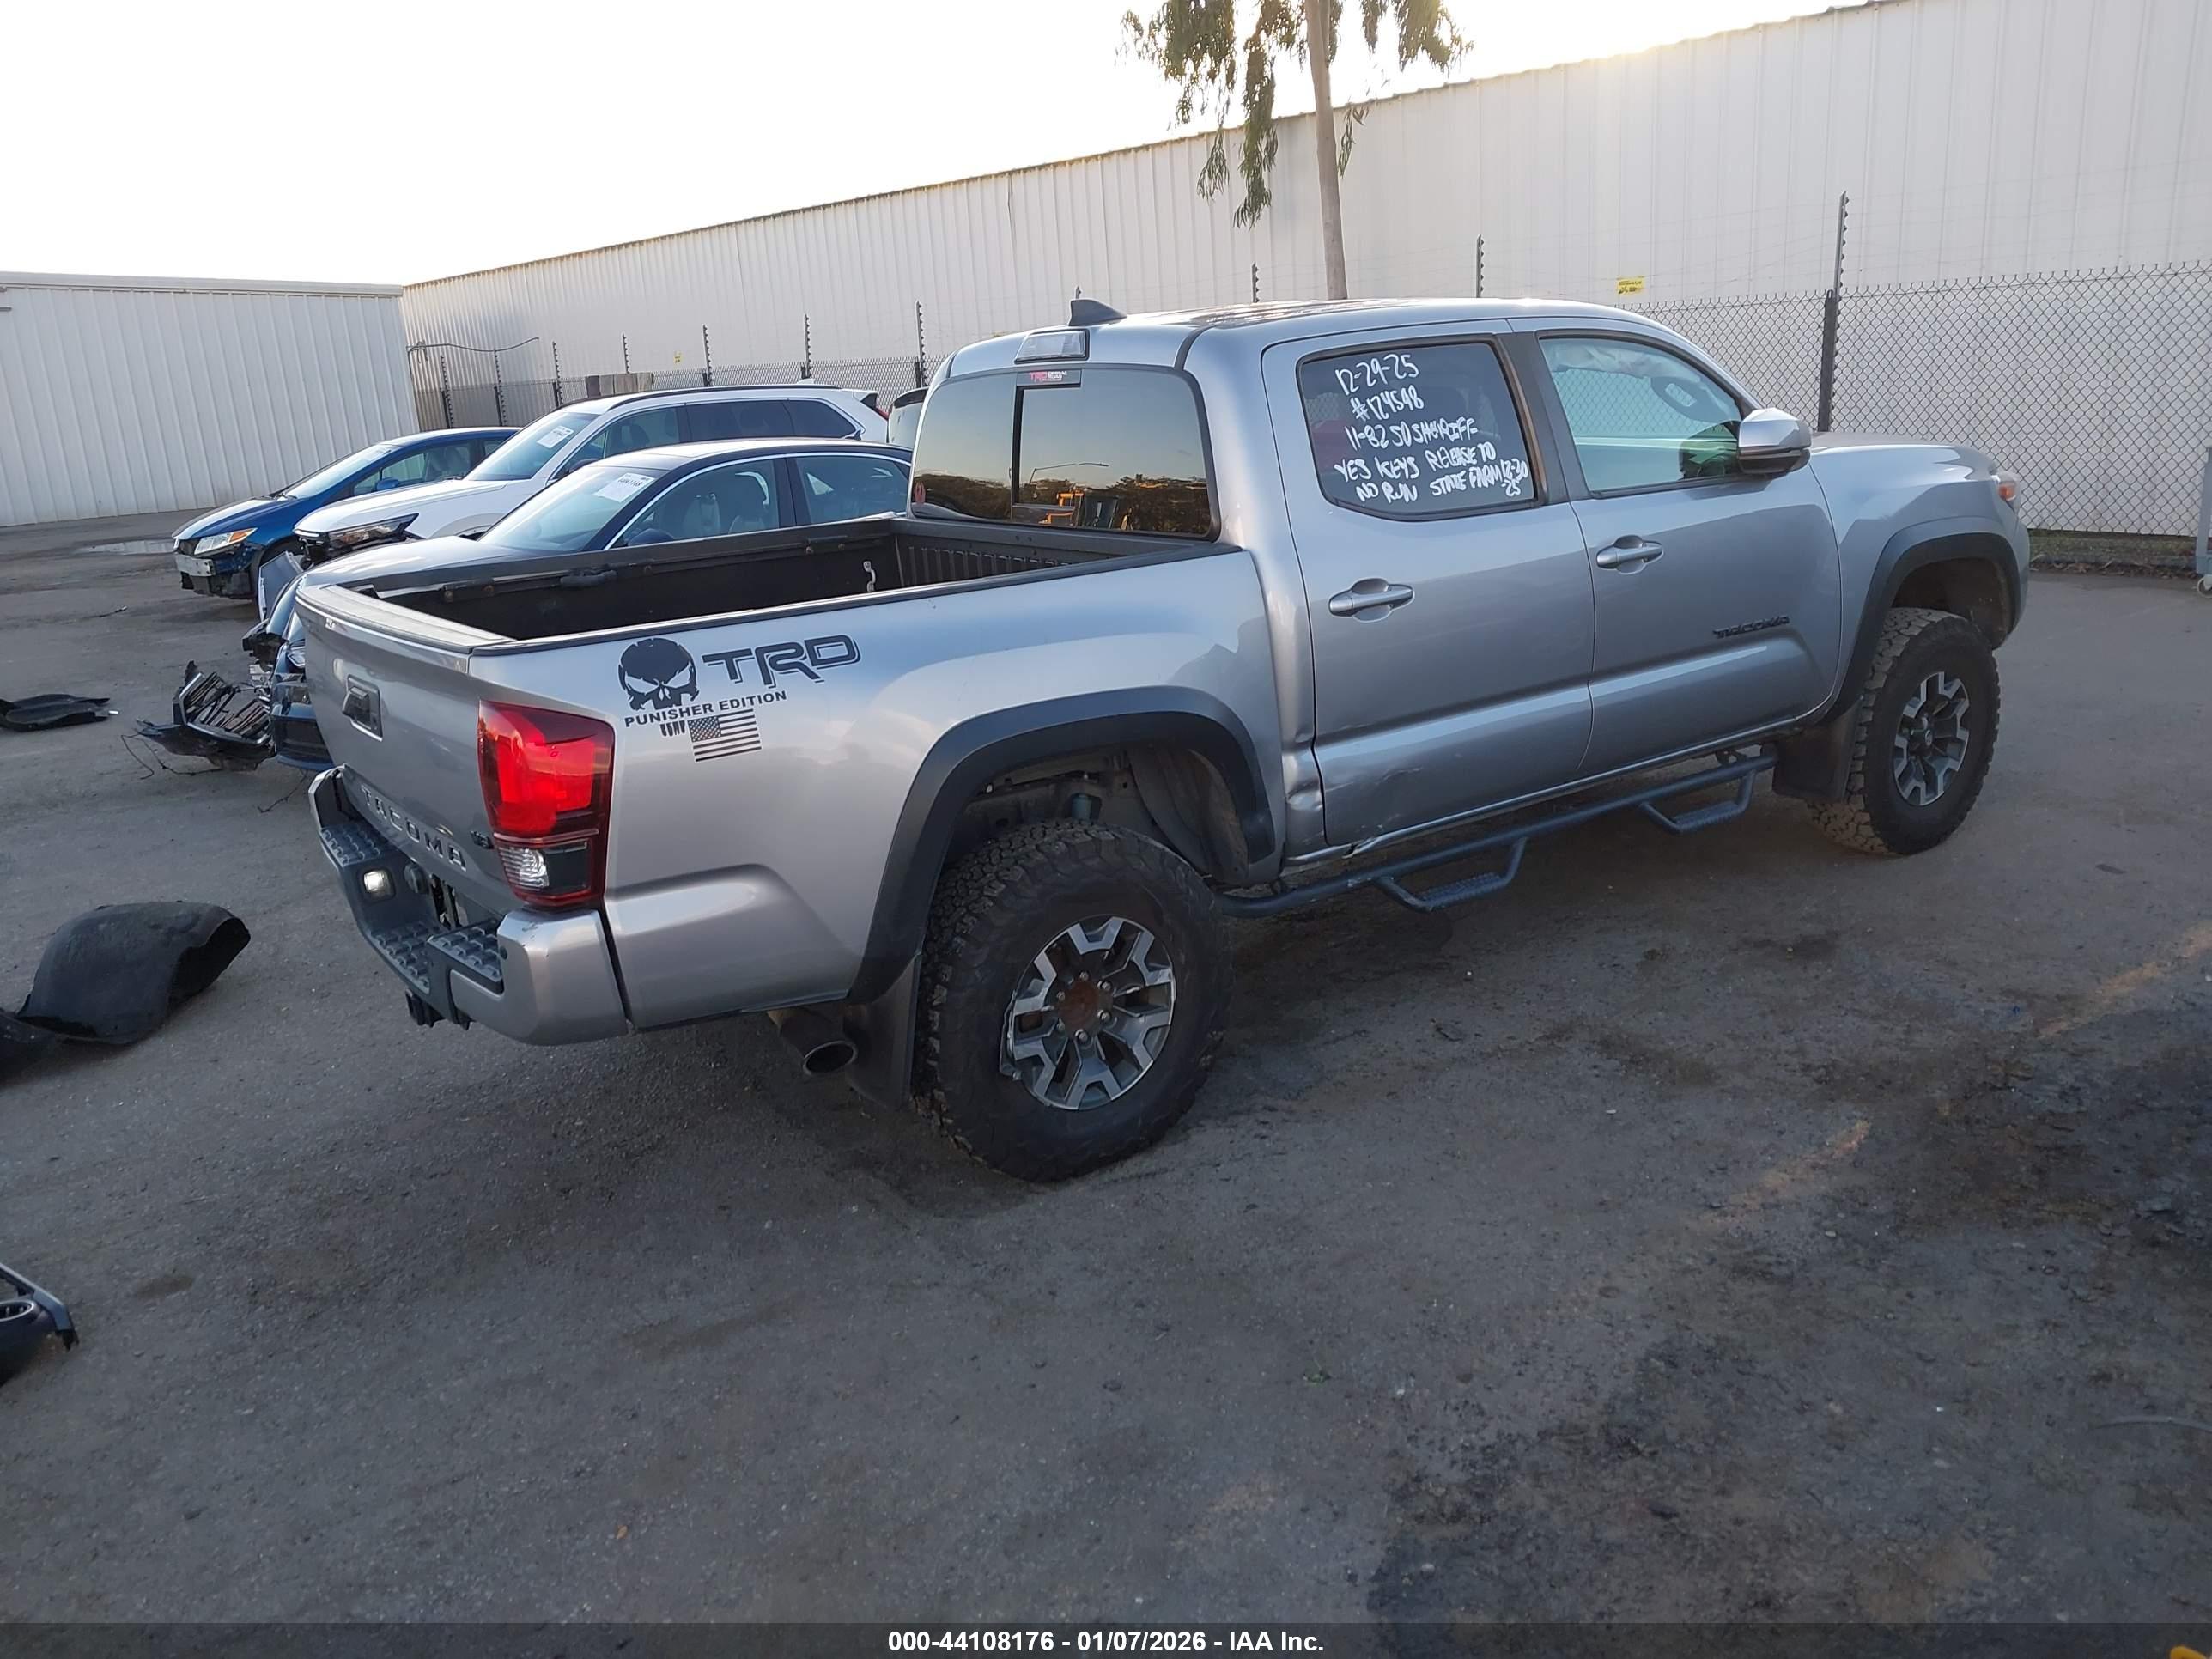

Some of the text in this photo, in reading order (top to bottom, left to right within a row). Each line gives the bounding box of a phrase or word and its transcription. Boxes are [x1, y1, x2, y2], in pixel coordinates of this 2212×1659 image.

[1334, 353, 1419, 396] 12-29-25
[1477, 441, 1497, 463] TO
[1334, 455, 1419, 483] YES KEYS
[1429, 470, 1467, 496] STATE
[1468, 464, 1503, 489] FARM
[1355, 482, 1418, 504] NO RUN
[1711, 615, 1790, 639] TACOMA
[702, 635, 861, 689] TRD
[624, 690, 787, 728] PUNISHER EDITION
[361, 784, 467, 872] TACOMA
